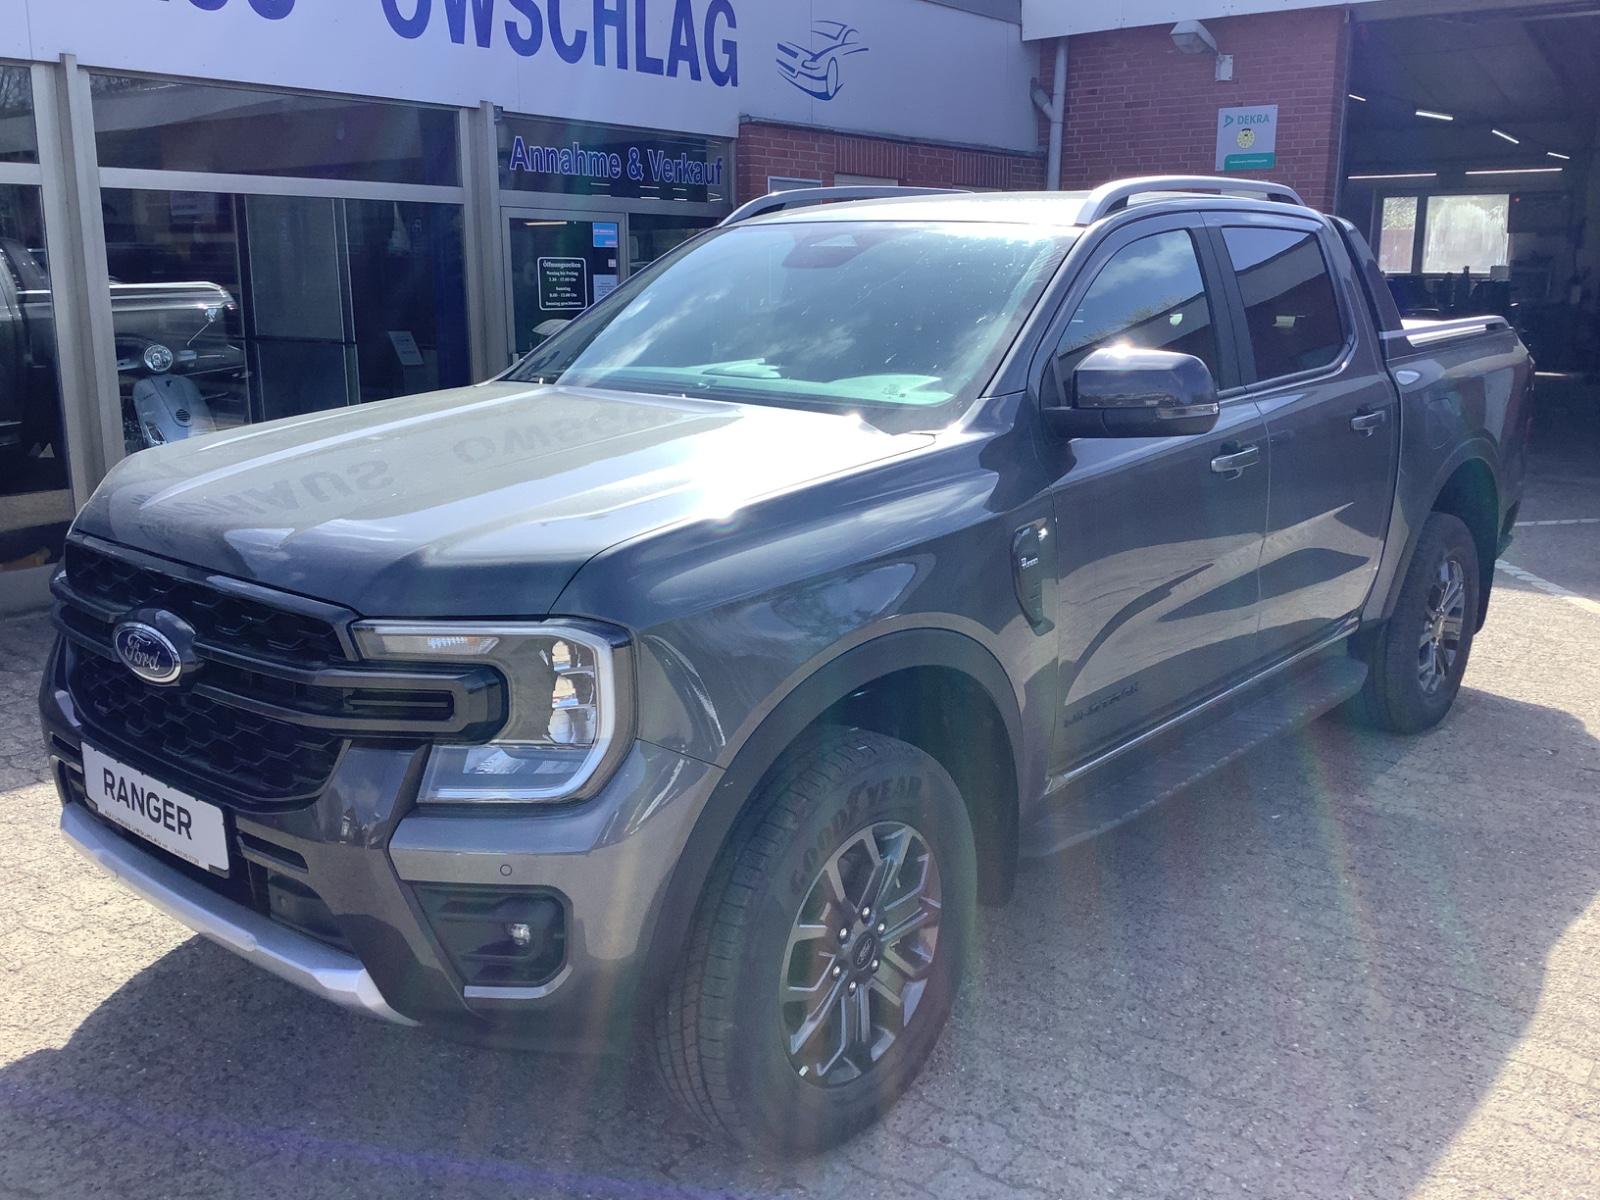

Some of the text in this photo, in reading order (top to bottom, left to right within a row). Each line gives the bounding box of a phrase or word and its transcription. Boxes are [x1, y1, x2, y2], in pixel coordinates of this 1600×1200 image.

[1237, 114, 1270, 125] DEKRA
[509, 136, 723, 185] Annahme & Verkauf
[124, 632, 160, 672] Ford
[103, 767, 193, 841] RANGER
